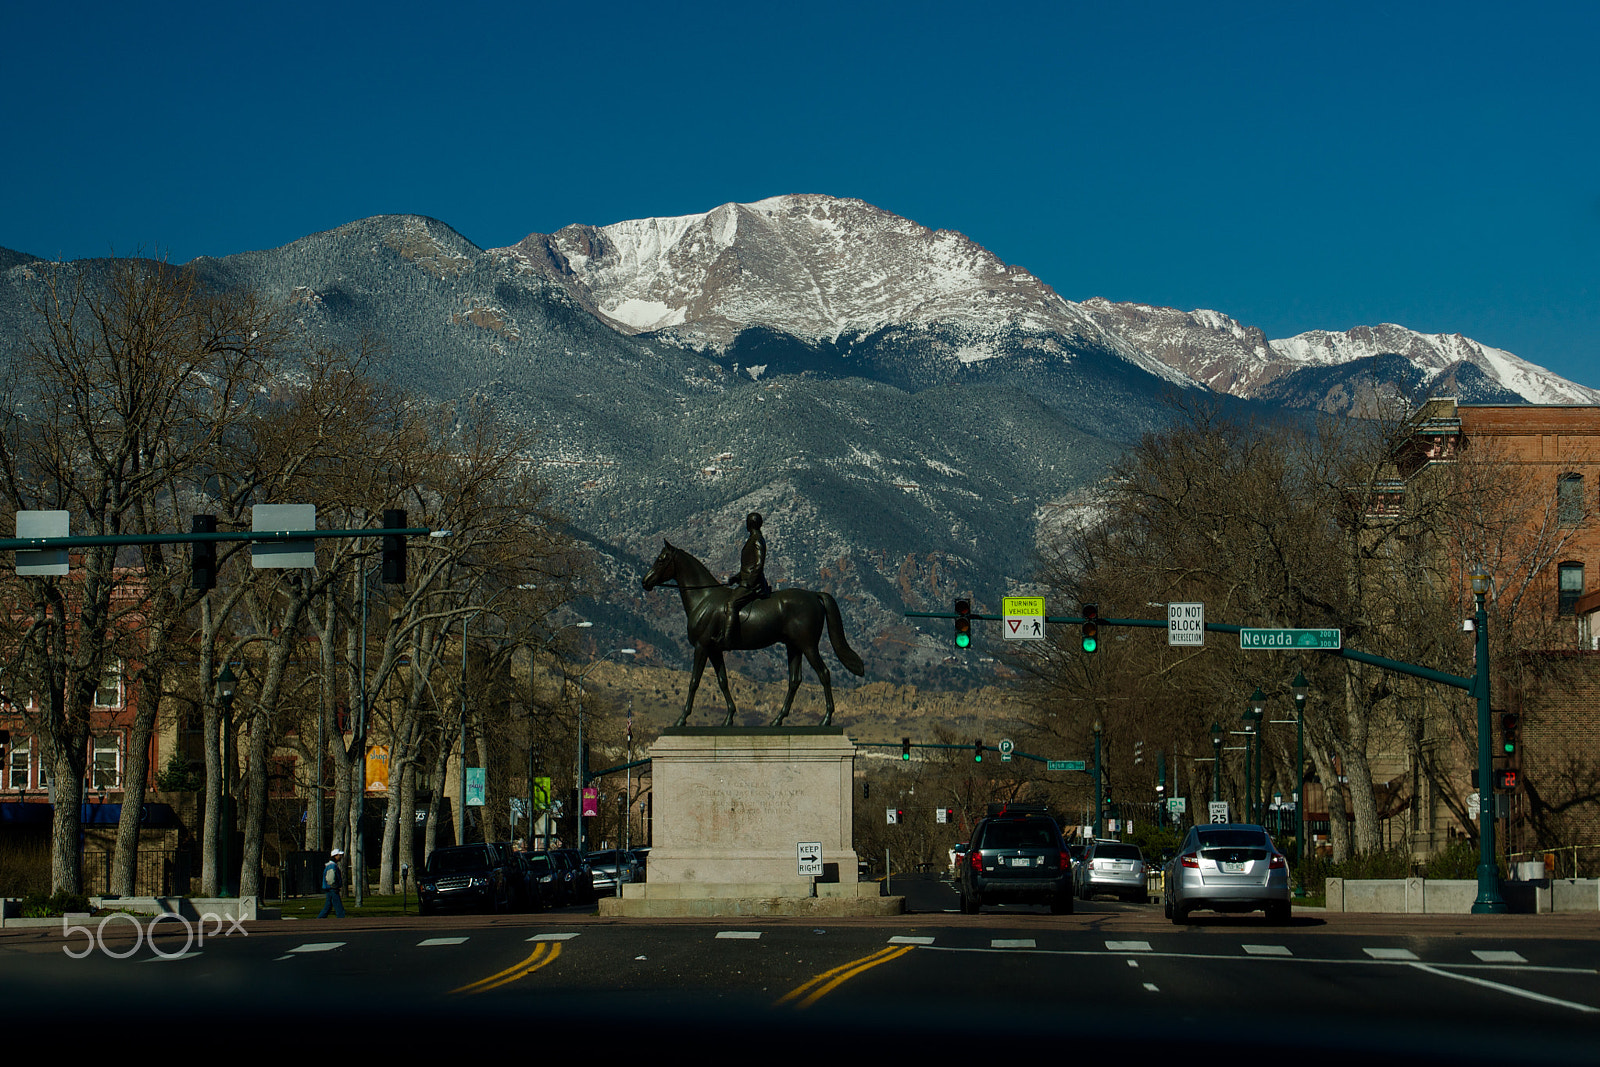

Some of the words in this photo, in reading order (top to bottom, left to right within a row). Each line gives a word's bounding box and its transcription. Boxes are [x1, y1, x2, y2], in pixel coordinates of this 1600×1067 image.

[1171, 606, 1182, 618] DO
[1185, 606, 1201, 618] NOT
[1171, 619, 1201, 631] BLOCK
[1171, 633, 1202, 642] INTERSECTION
[1243, 631, 1292, 646] Nevada
[1319, 630, 1332, 638] 200
[1003, 742, 1010, 751] P
[370, 749, 388, 765] shop
[468, 780, 483, 793] play
[1211, 814, 1227, 824] 25
[800, 845, 819, 854] KEEP
[799, 864, 821, 872] RIGHT
